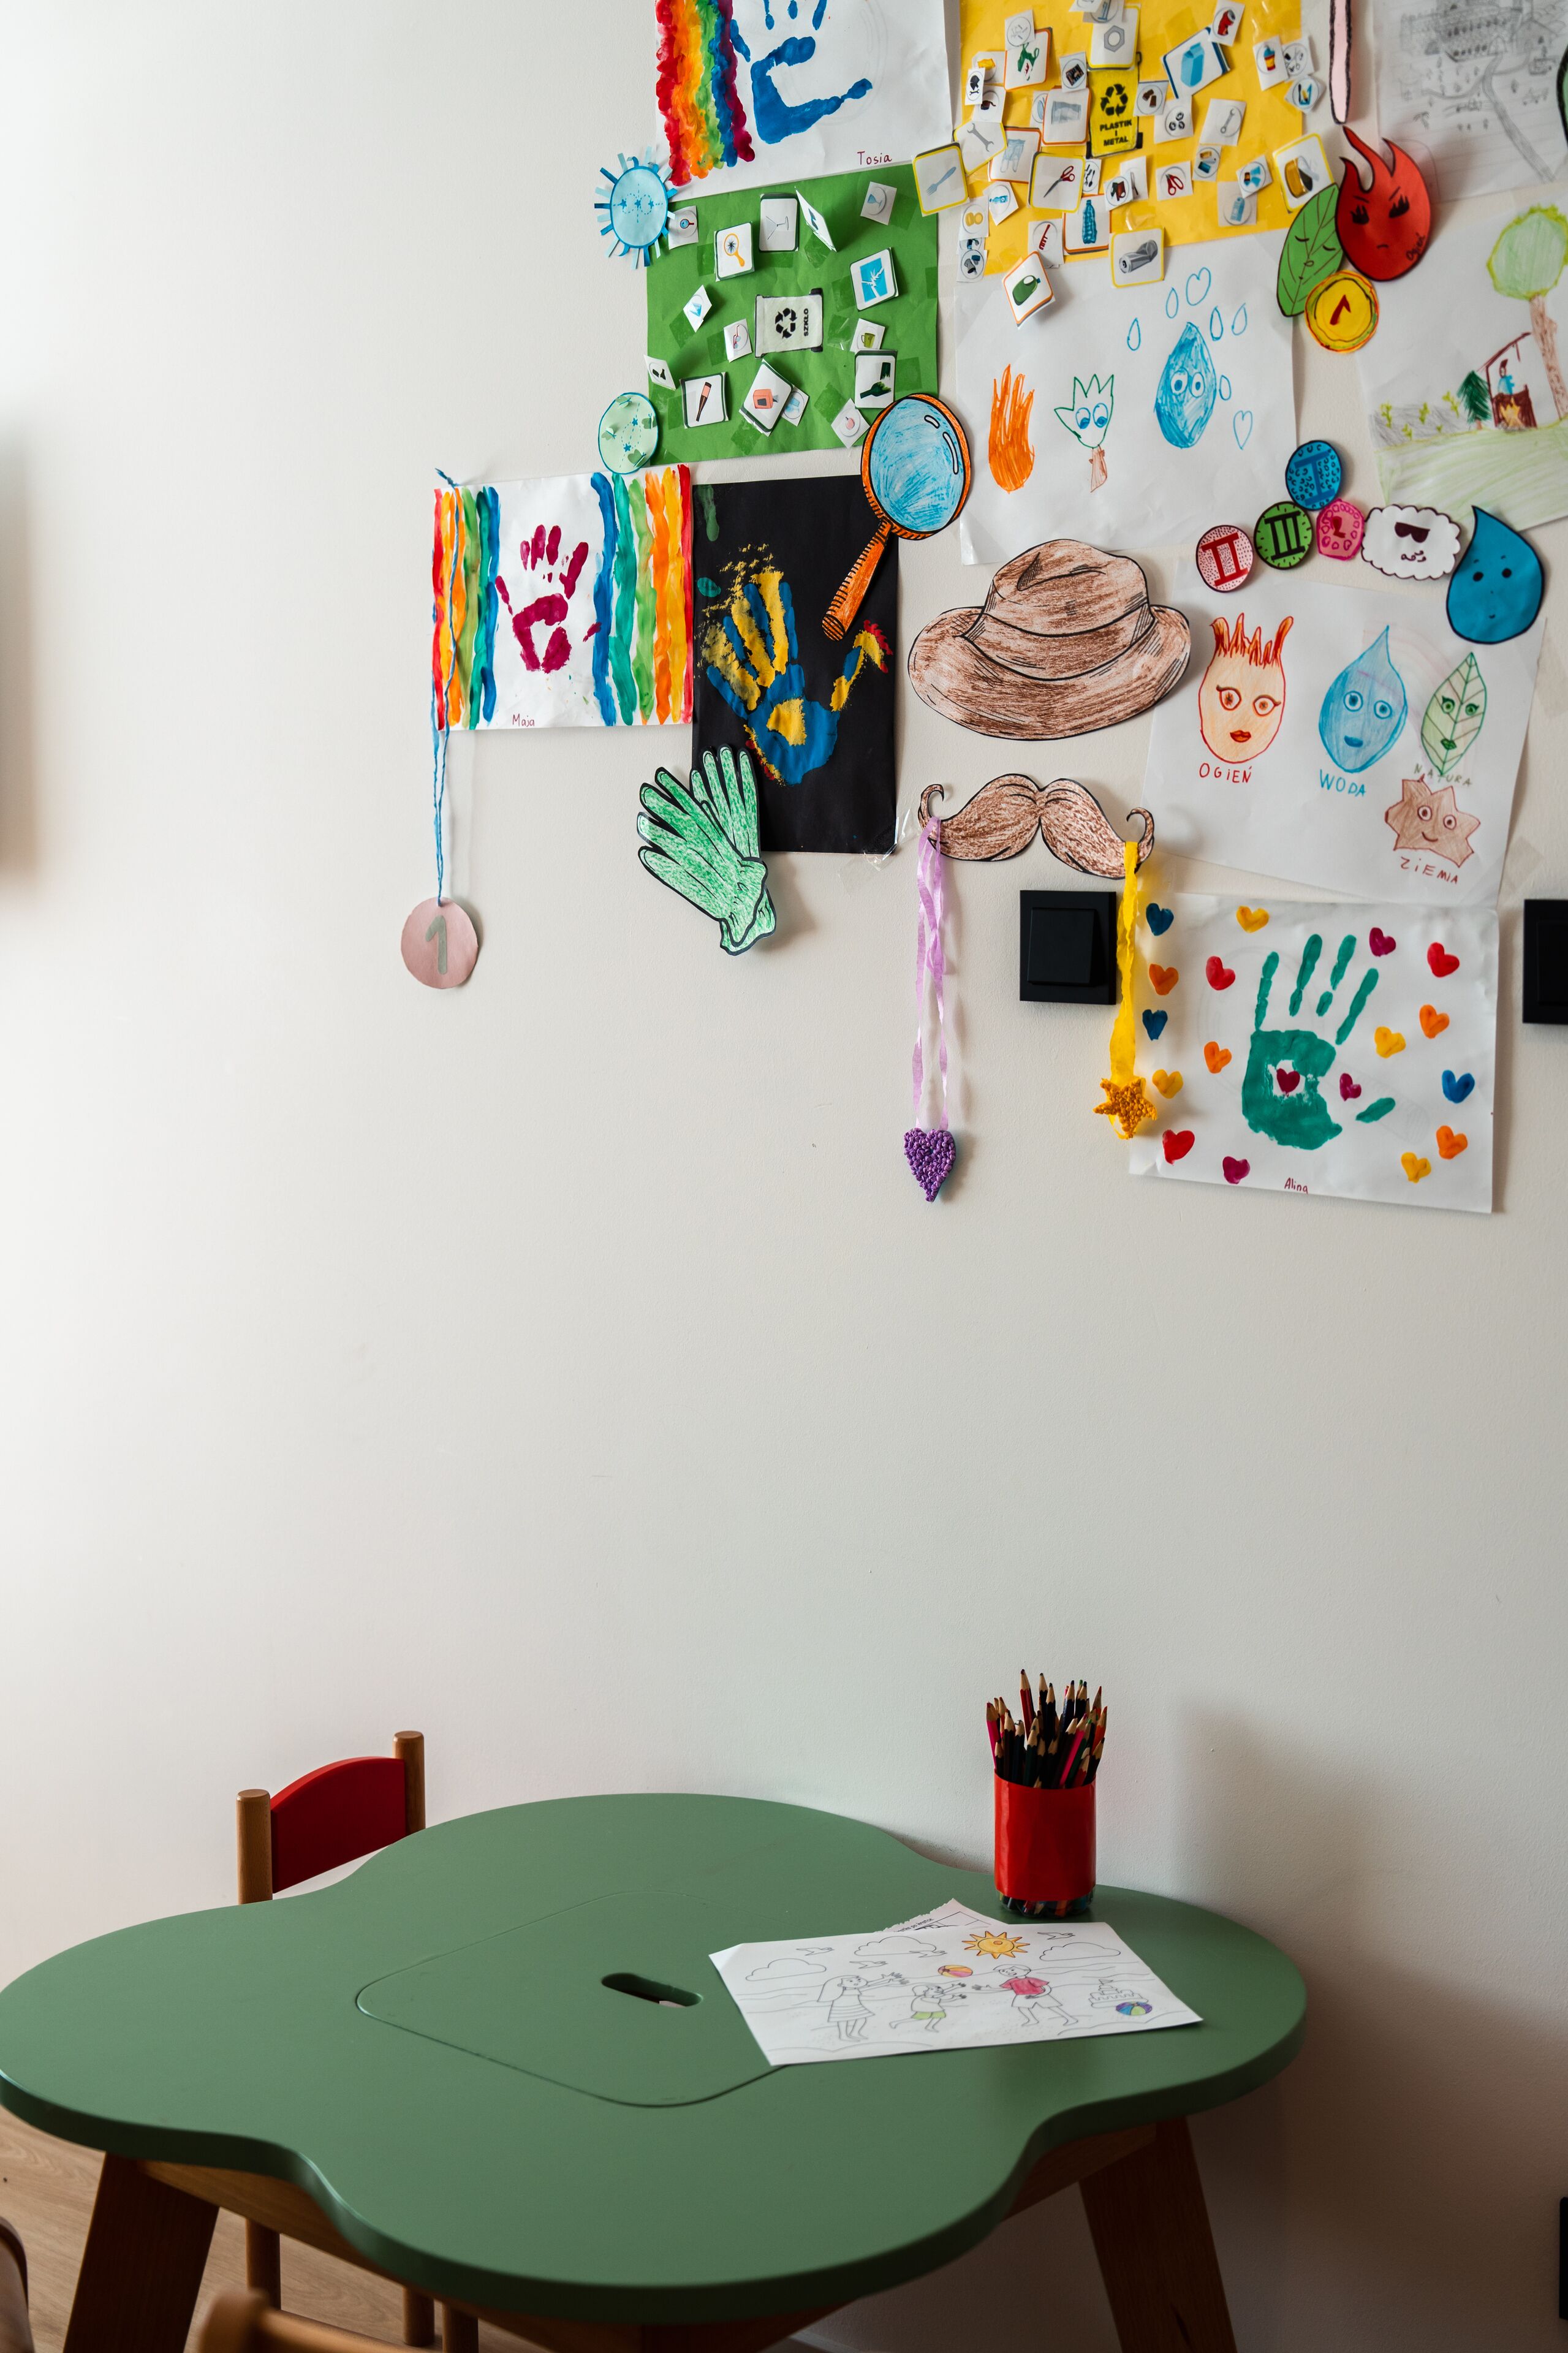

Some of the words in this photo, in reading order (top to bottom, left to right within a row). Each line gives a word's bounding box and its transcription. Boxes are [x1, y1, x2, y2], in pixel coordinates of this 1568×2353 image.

[1100, 119, 1132, 132] PLASTIK
[1104, 136, 1129, 146] METAL
[857, 151, 892, 165] Tosia
[512, 713, 534, 727] Maja
[1414, 763, 1472, 787] NATURA
[1320, 769, 1366, 797] WODA
[425, 915, 448, 974] 1
[1284, 1177, 1308, 1194] Alina
